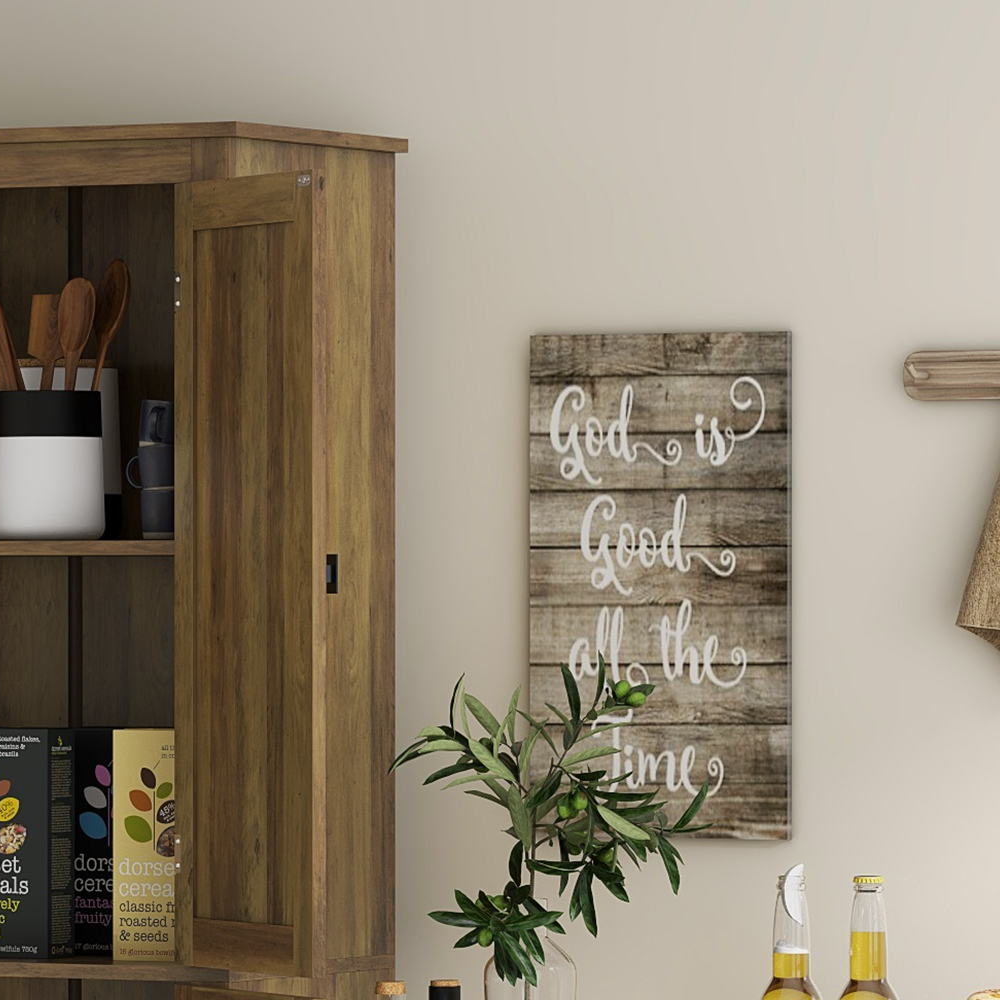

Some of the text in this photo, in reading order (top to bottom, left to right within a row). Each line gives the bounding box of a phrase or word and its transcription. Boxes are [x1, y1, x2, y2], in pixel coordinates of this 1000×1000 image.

[550, 377, 766, 485] God is
[580, 494, 736, 596] Good
[568, 600, 747, 692] all the
[590, 674, 724, 798] Time
[119, 901, 163, 913] classic
[74, 912, 112, 927] fruity
[119, 916, 168, 927] roasted
[119, 929, 169, 942] & seeds
[82, 943, 109, 951] glorious
[128, 948, 154, 956] glorious
